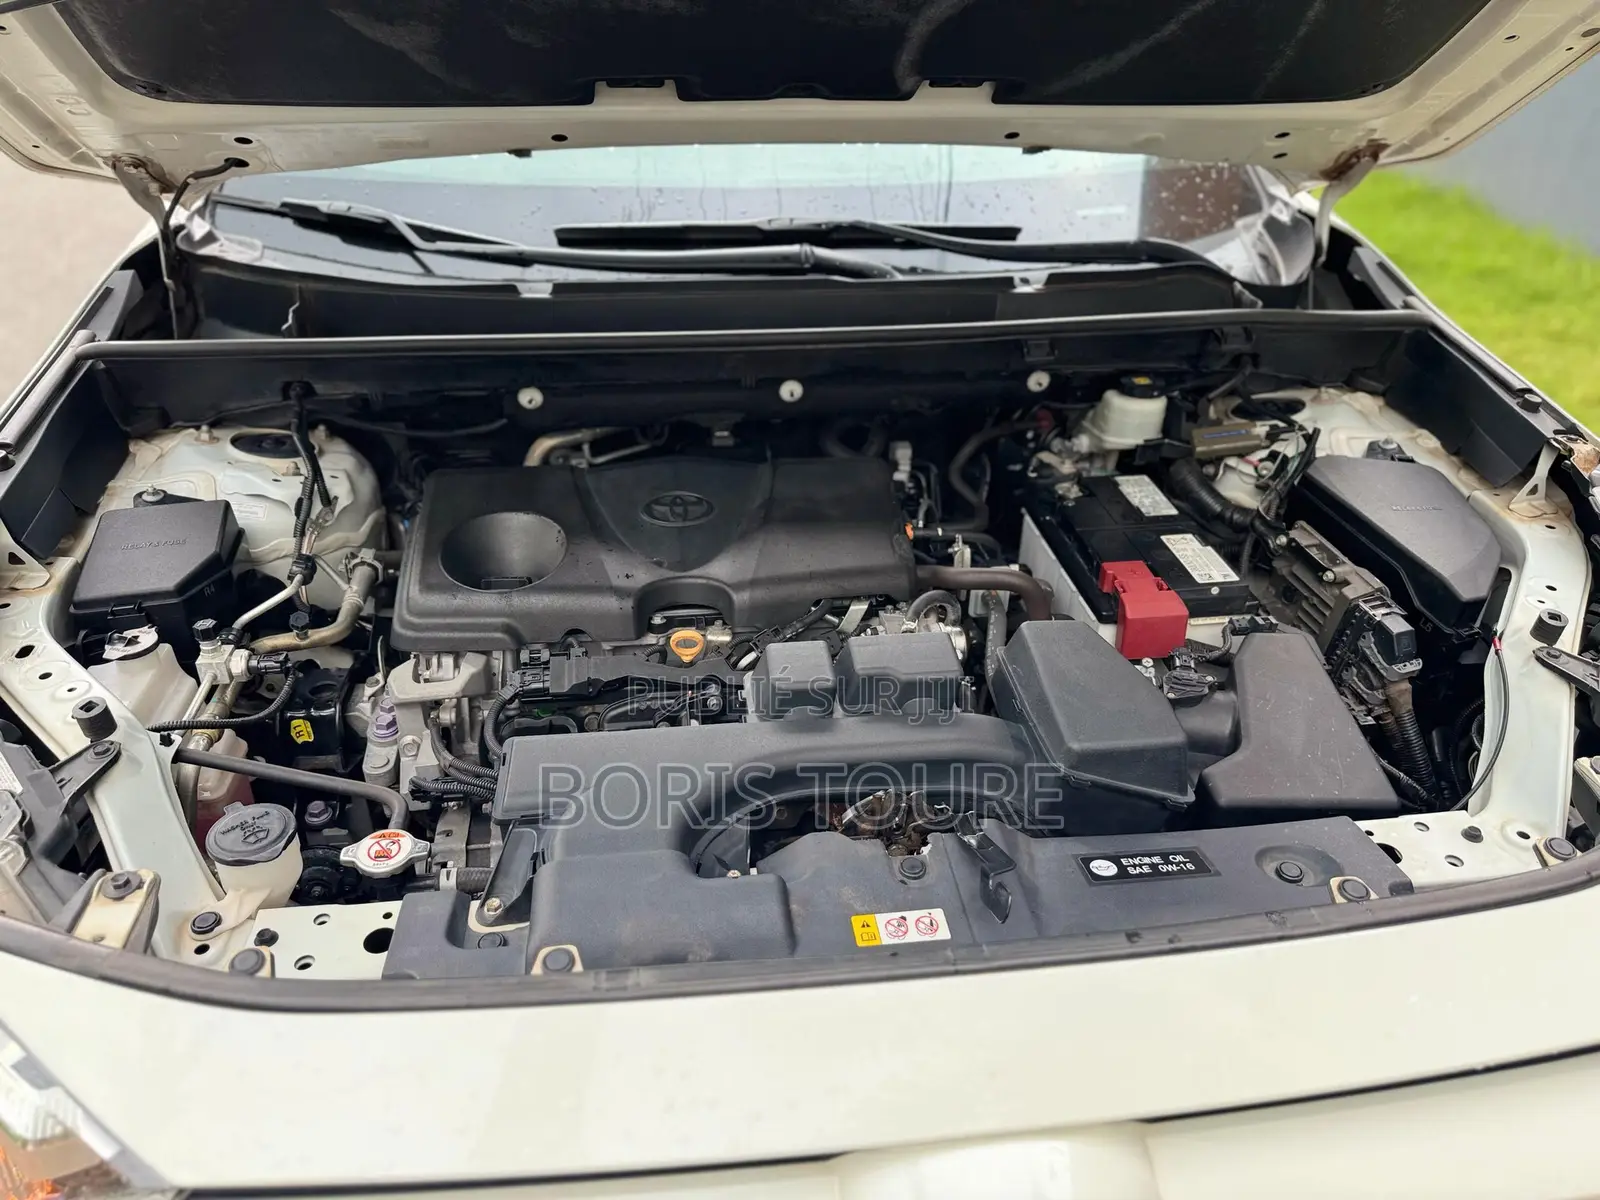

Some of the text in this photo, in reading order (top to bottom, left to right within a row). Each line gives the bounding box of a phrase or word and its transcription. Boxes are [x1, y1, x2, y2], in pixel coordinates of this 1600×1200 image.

[1120, 854, 1190, 866] ENGINE OIL
[1126, 863, 1196, 874] SAE 0W-16
